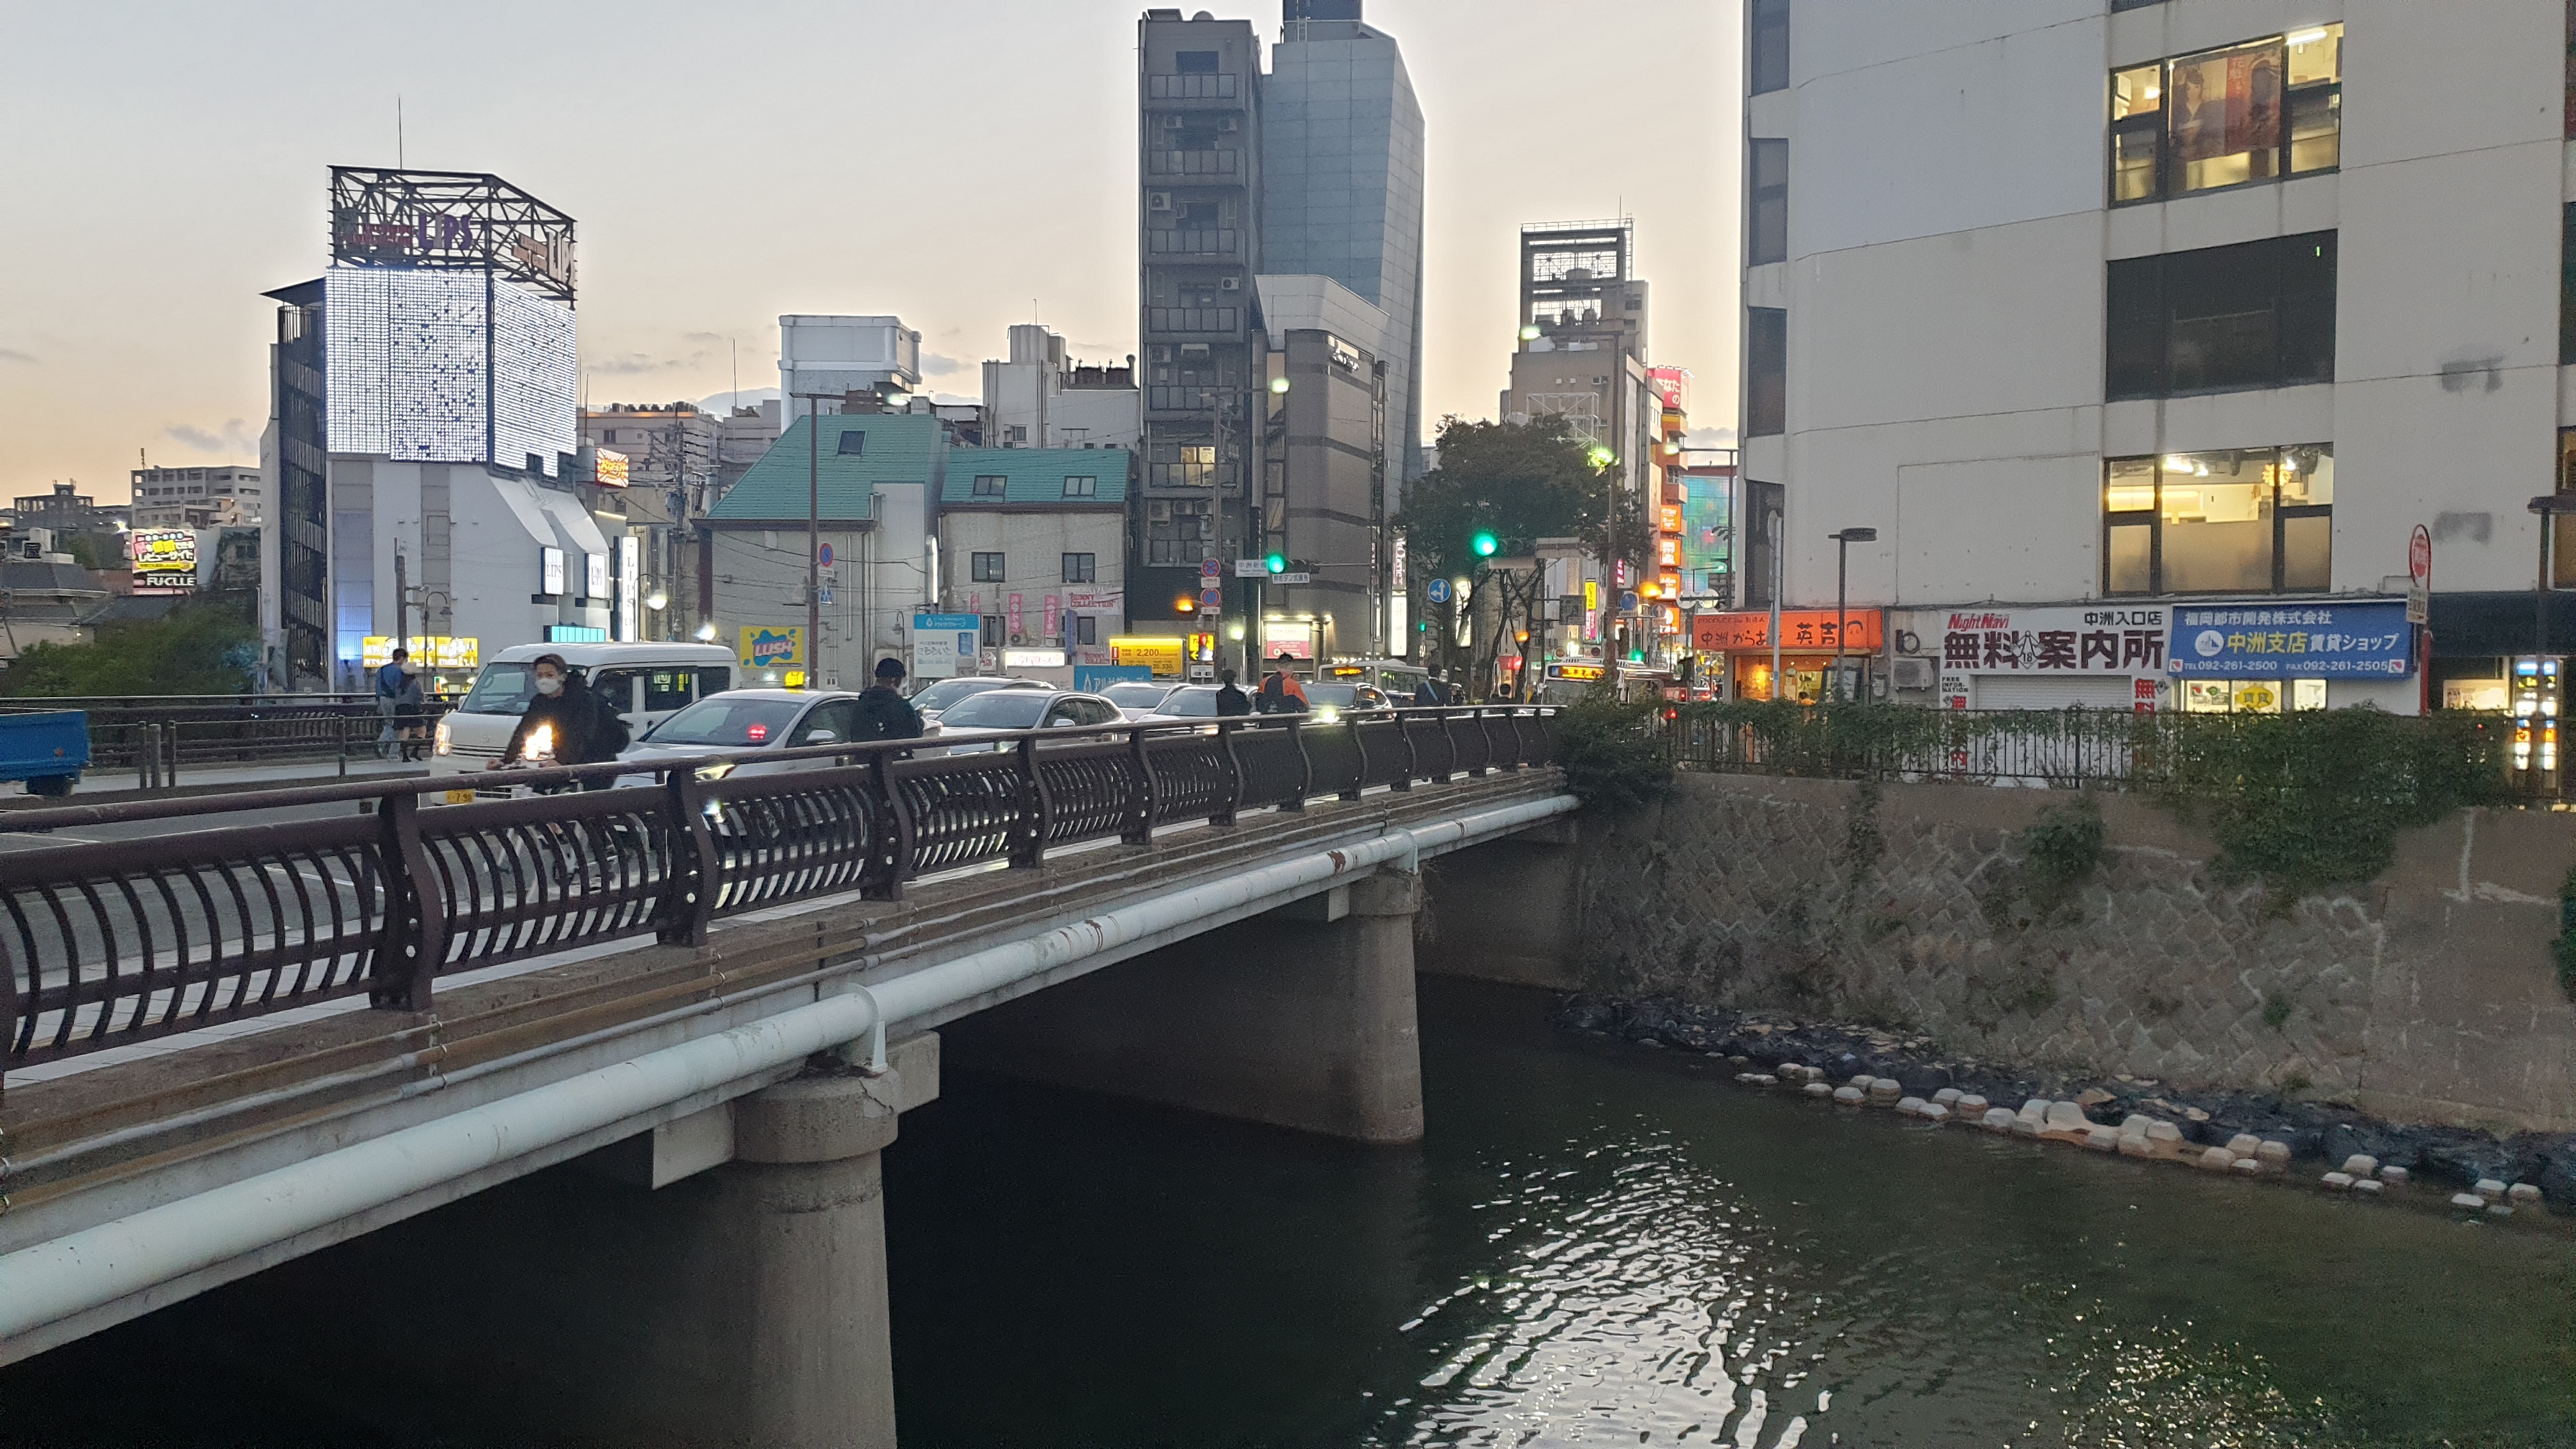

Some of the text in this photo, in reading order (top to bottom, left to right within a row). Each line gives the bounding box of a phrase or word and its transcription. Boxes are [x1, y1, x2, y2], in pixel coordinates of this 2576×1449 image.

[418, 211, 473, 250] LIPS
[548, 232, 576, 287] LIPS
[546, 564, 562, 578] LIPS
[2085, 611, 2163, 627] 中洲入口店
[2185, 610, 2333, 626] 福岡都市開発株式会社
[1701, 630, 1782, 648] 中洲からあ
[2227, 631, 2400, 654] 中洲支店 賃貸ショップ
[754, 640, 792, 657] LUSH
[1137, 648, 1160, 657] 2,200
[1944, 629, 2165, 670] 無料案内所
[2023, 651, 2033, 663] 18
[2198, 661, 2277, 670] 092-261-2500
[2303, 660, 2388, 671] 092-261-2505
